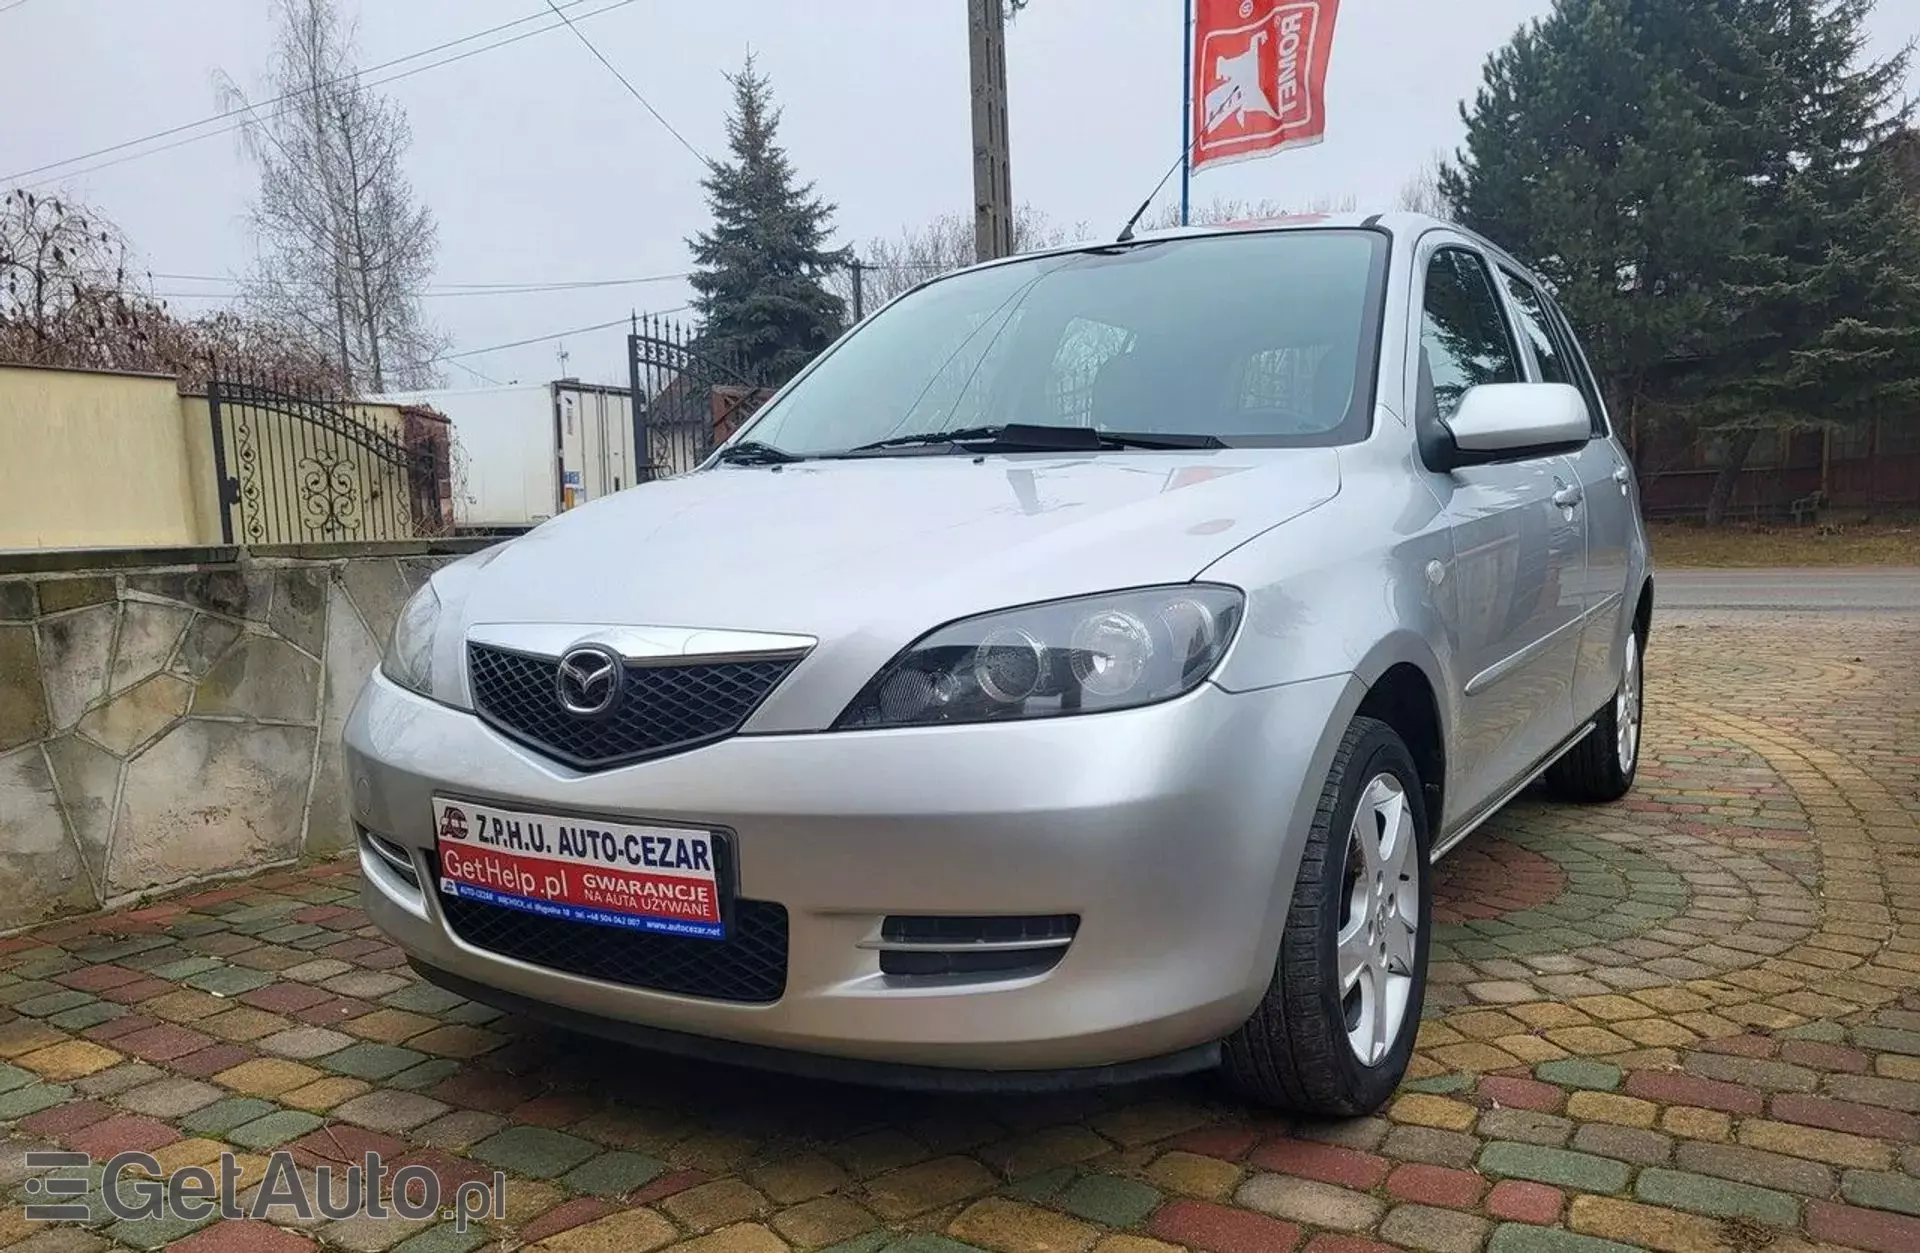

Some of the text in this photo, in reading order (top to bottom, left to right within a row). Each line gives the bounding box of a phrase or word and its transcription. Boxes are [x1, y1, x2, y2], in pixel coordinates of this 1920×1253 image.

[476, 813, 711, 871] Z.P.H.U. AUTO-CEZAR
[582, 873, 710, 903] GWARANCJE
[583, 889, 711, 917] NA AUTA UŻYWANE
